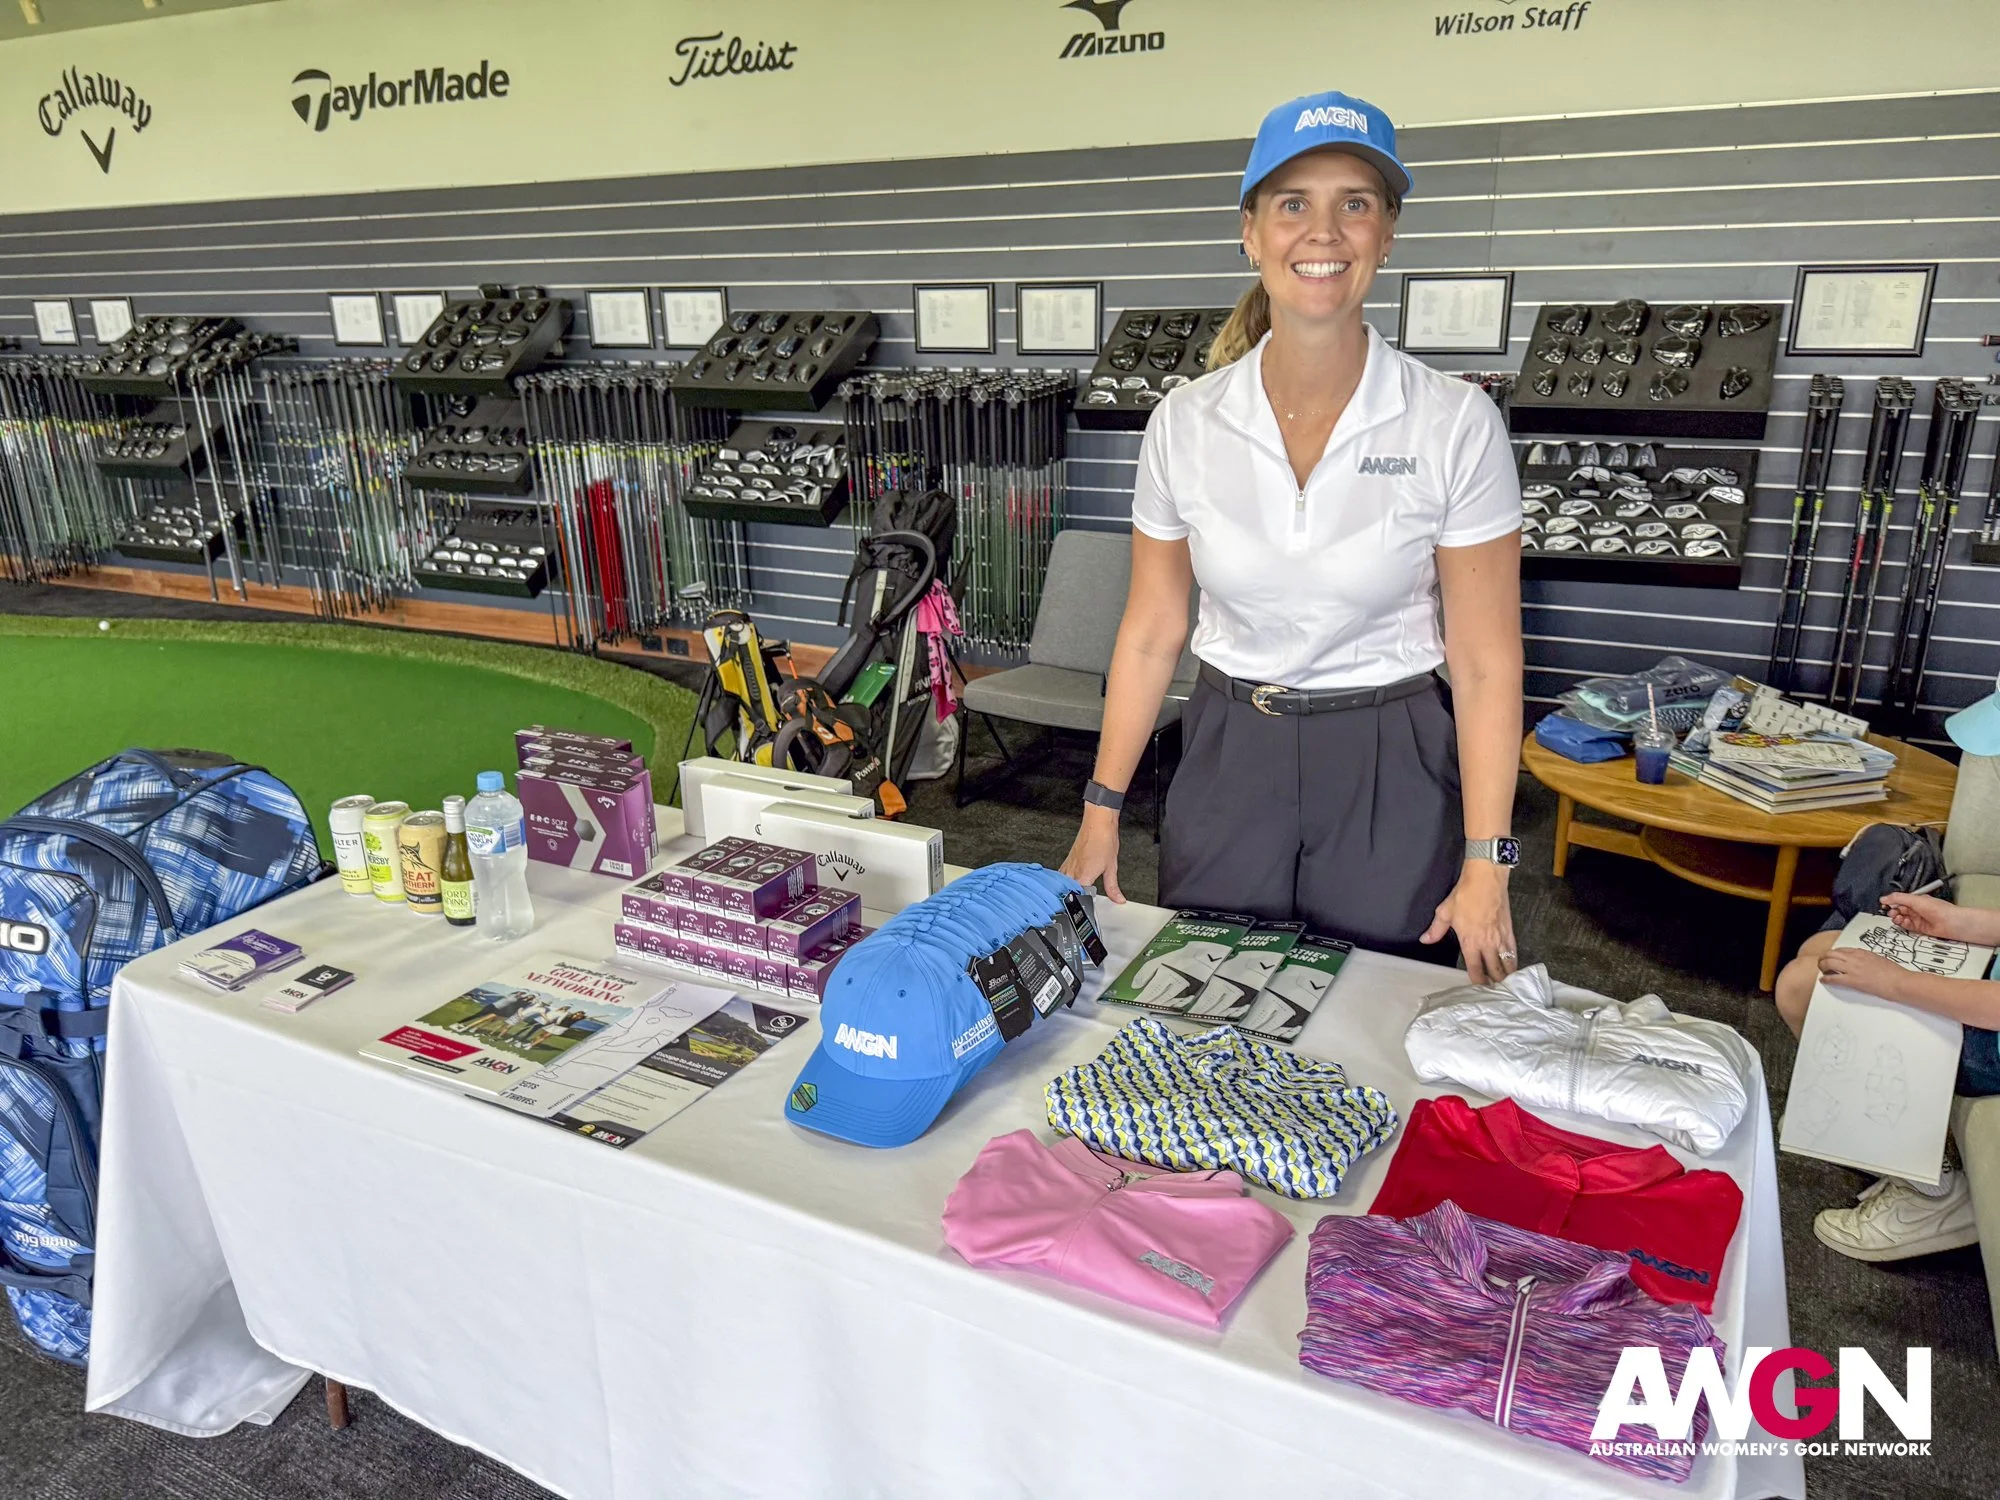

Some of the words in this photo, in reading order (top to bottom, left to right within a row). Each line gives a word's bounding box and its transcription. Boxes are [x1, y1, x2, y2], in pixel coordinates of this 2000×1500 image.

[1434, 14, 1514, 36] Wilson
[1521, 1, 1592, 31] Staff
[669, 31, 797, 86] Titleist
[38, 64, 152, 137] Callaway
[291, 61, 510, 132] TaylorMade
[1294, 106, 1368, 134] AWGN
[1359, 457, 1416, 475] AWGN
[1664, 684, 1701, 699] zero
[816, 850, 866, 876] Callaway
[0, 921, 44, 952] IO
[1175, 923, 1229, 935] WEATHER
[1177, 929, 1218, 938] SPANN
[1241, 935, 1280, 943] ATHER
[1289, 947, 1329, 960] ATHER
[526, 972, 625, 1004] NETWORKING
[549, 968, 590, 983] GOLF
[590, 979, 624, 992] AND
[280, 988, 308, 999] AWGN
[834, 1022, 897, 1060] AWGN
[952, 1013, 994, 1050] HUTCHING
[471, 1057, 520, 1075] AWGN
[1633, 1053, 1703, 1077] AWGN
[519, 1080, 540, 1090] ECTS
[591, 1130, 626, 1145] AWGN
[1136, 1249, 1216, 1296] AWGN
[1628, 1248, 1711, 1286] AWGN
